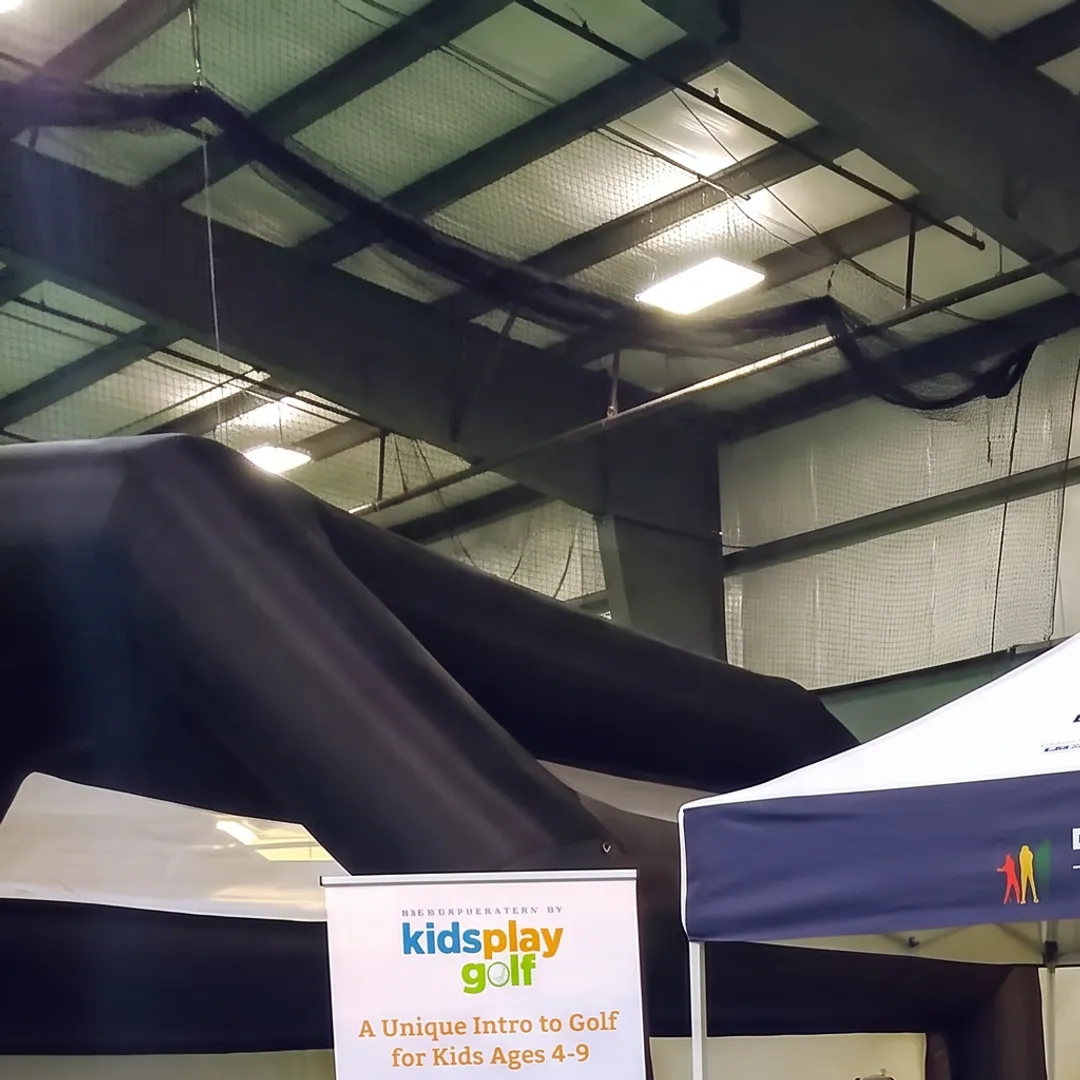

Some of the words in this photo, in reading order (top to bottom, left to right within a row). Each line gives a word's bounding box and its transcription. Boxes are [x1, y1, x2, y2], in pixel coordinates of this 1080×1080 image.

[401, 919, 564, 960] kidsplay
[461, 953, 537, 994] golf
[358, 1019, 377, 1038] A
[380, 1016, 468, 1041] Unique
[472, 1016, 533, 1035] Intro
[539, 1014, 563, 1034] to
[568, 1011, 620, 1033] Golf
[391, 1048, 427, 1068] for
[432, 1047, 484, 1067] Kids
[490, 1045, 546, 1070] Ages
[551, 1043, 590, 1063] 4-9
